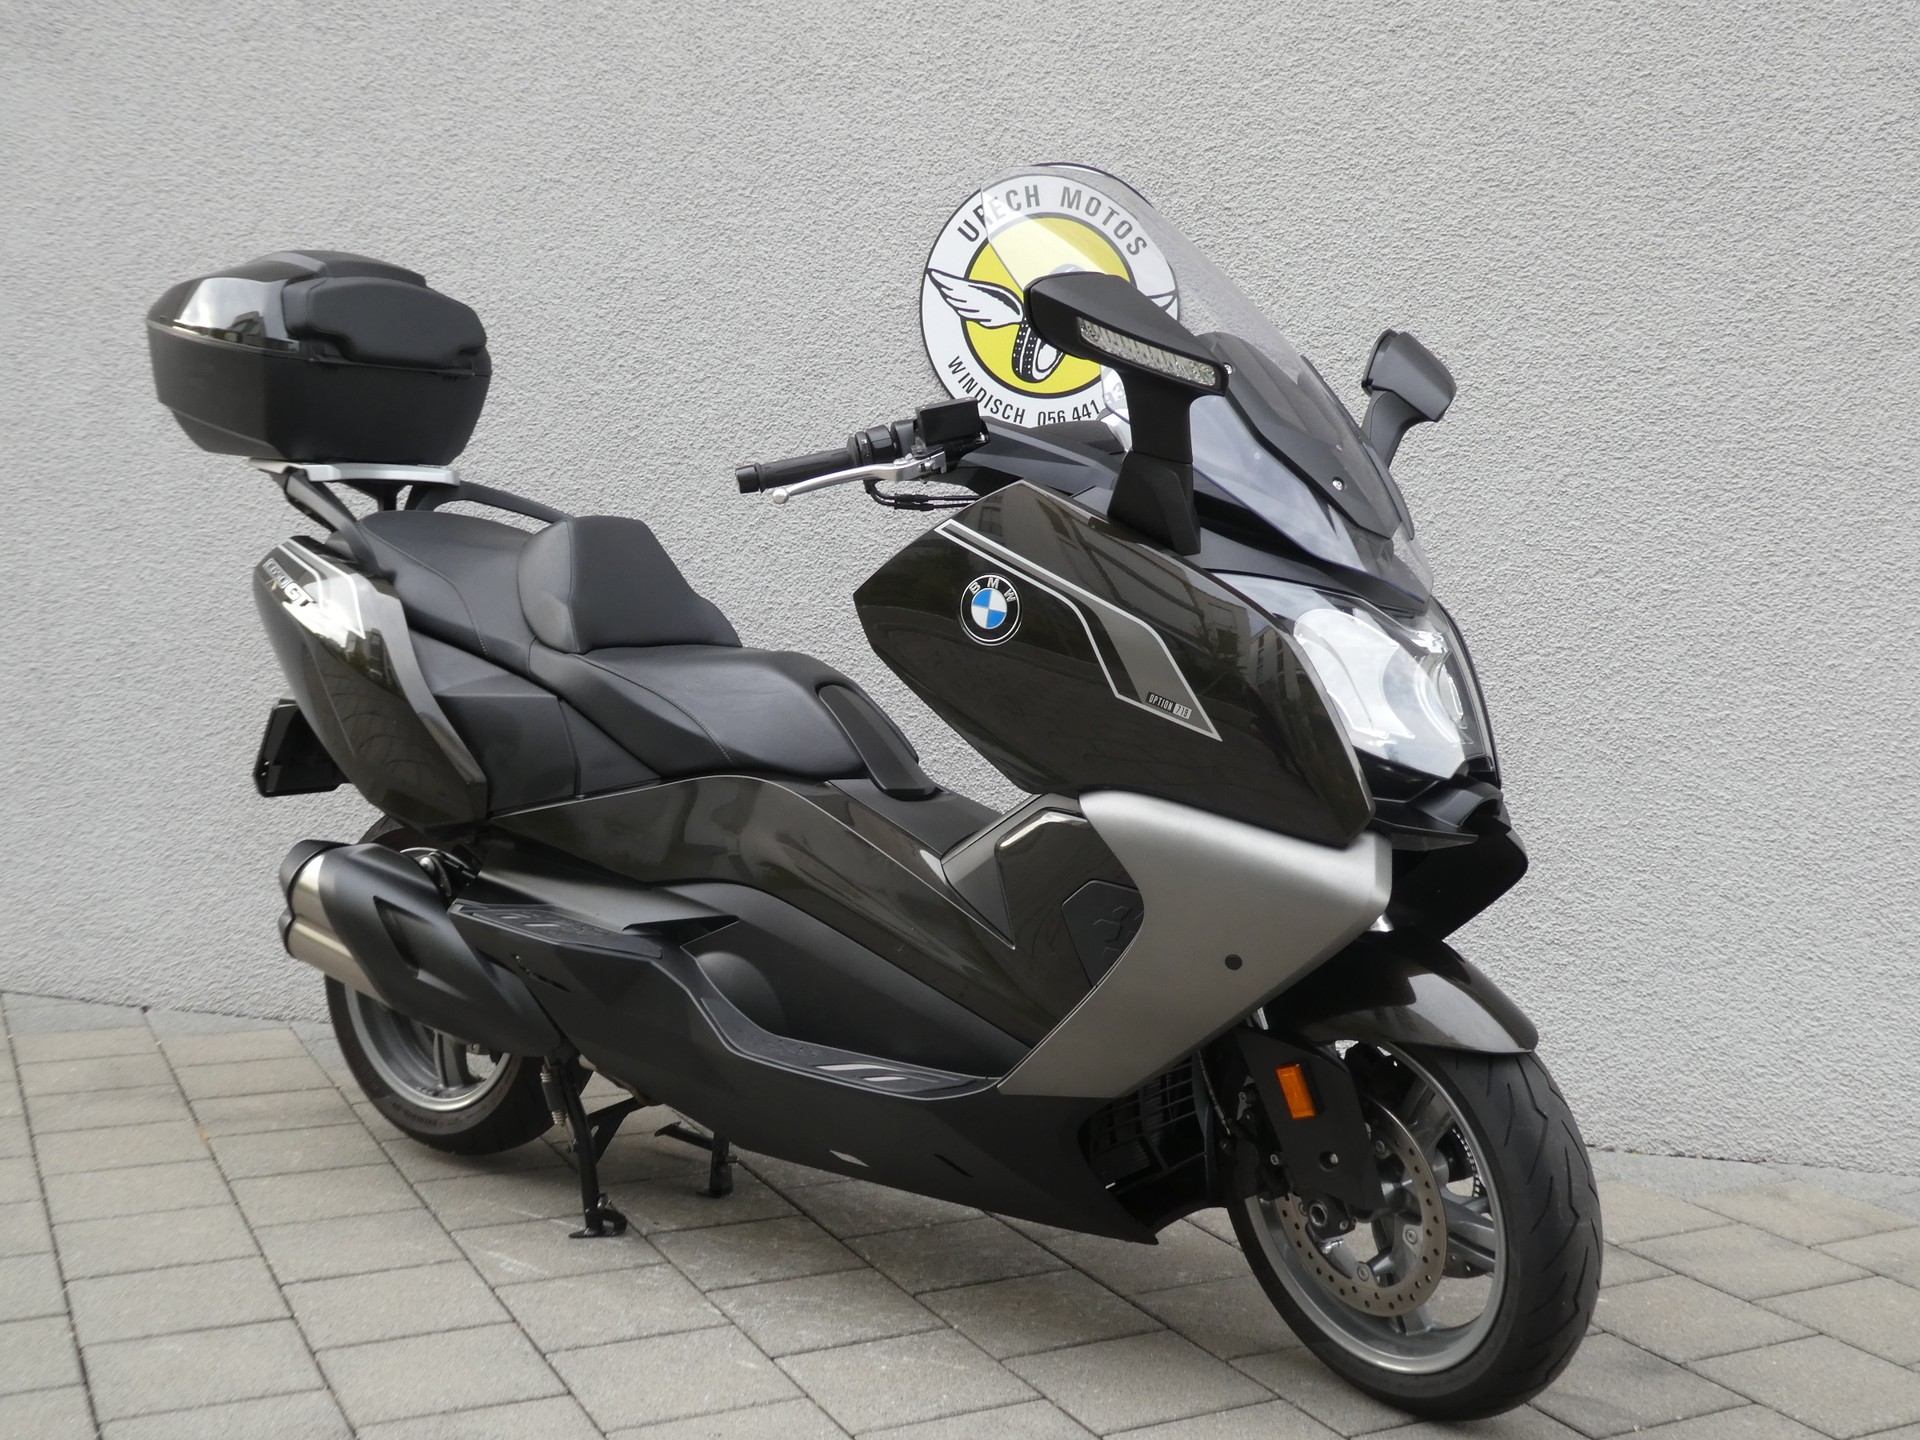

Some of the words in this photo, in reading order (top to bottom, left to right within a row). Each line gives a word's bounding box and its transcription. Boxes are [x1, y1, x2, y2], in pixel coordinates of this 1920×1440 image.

[957, 184, 1041, 243] URECH
[1060, 186, 1148, 256] MOTOS
[948, 356, 1026, 424] WINDISCH
[1037, 410, 1067, 426] 056
[1072, 399, 1100, 421] 441
[968, 576, 1017, 603] BMW
[1148, 693, 1174, 712] OPTION
